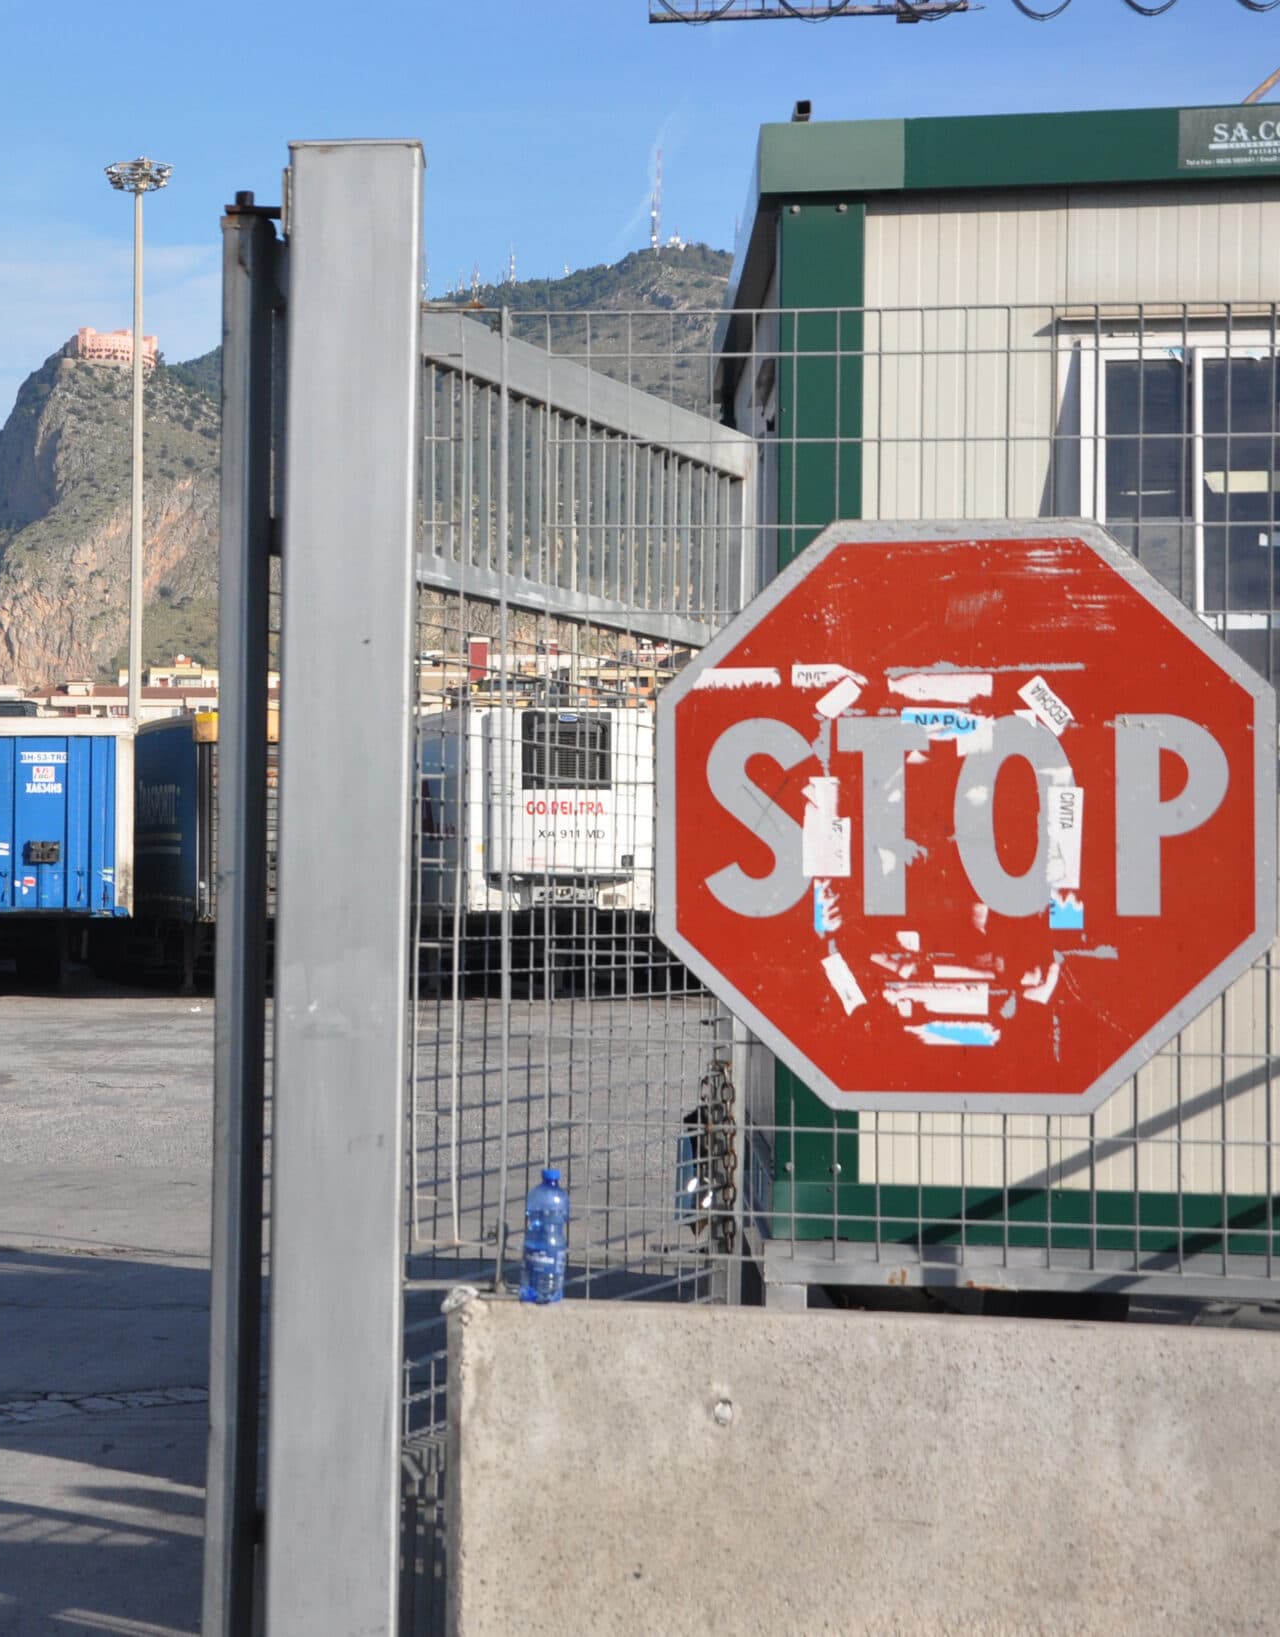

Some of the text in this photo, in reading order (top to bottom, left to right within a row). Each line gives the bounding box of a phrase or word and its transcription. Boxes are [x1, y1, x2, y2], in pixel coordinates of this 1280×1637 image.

[705, 714, 1229, 918] STOP
[1060, 792, 1075, 830] CIVITA
[560, 829, 580, 839] 911
